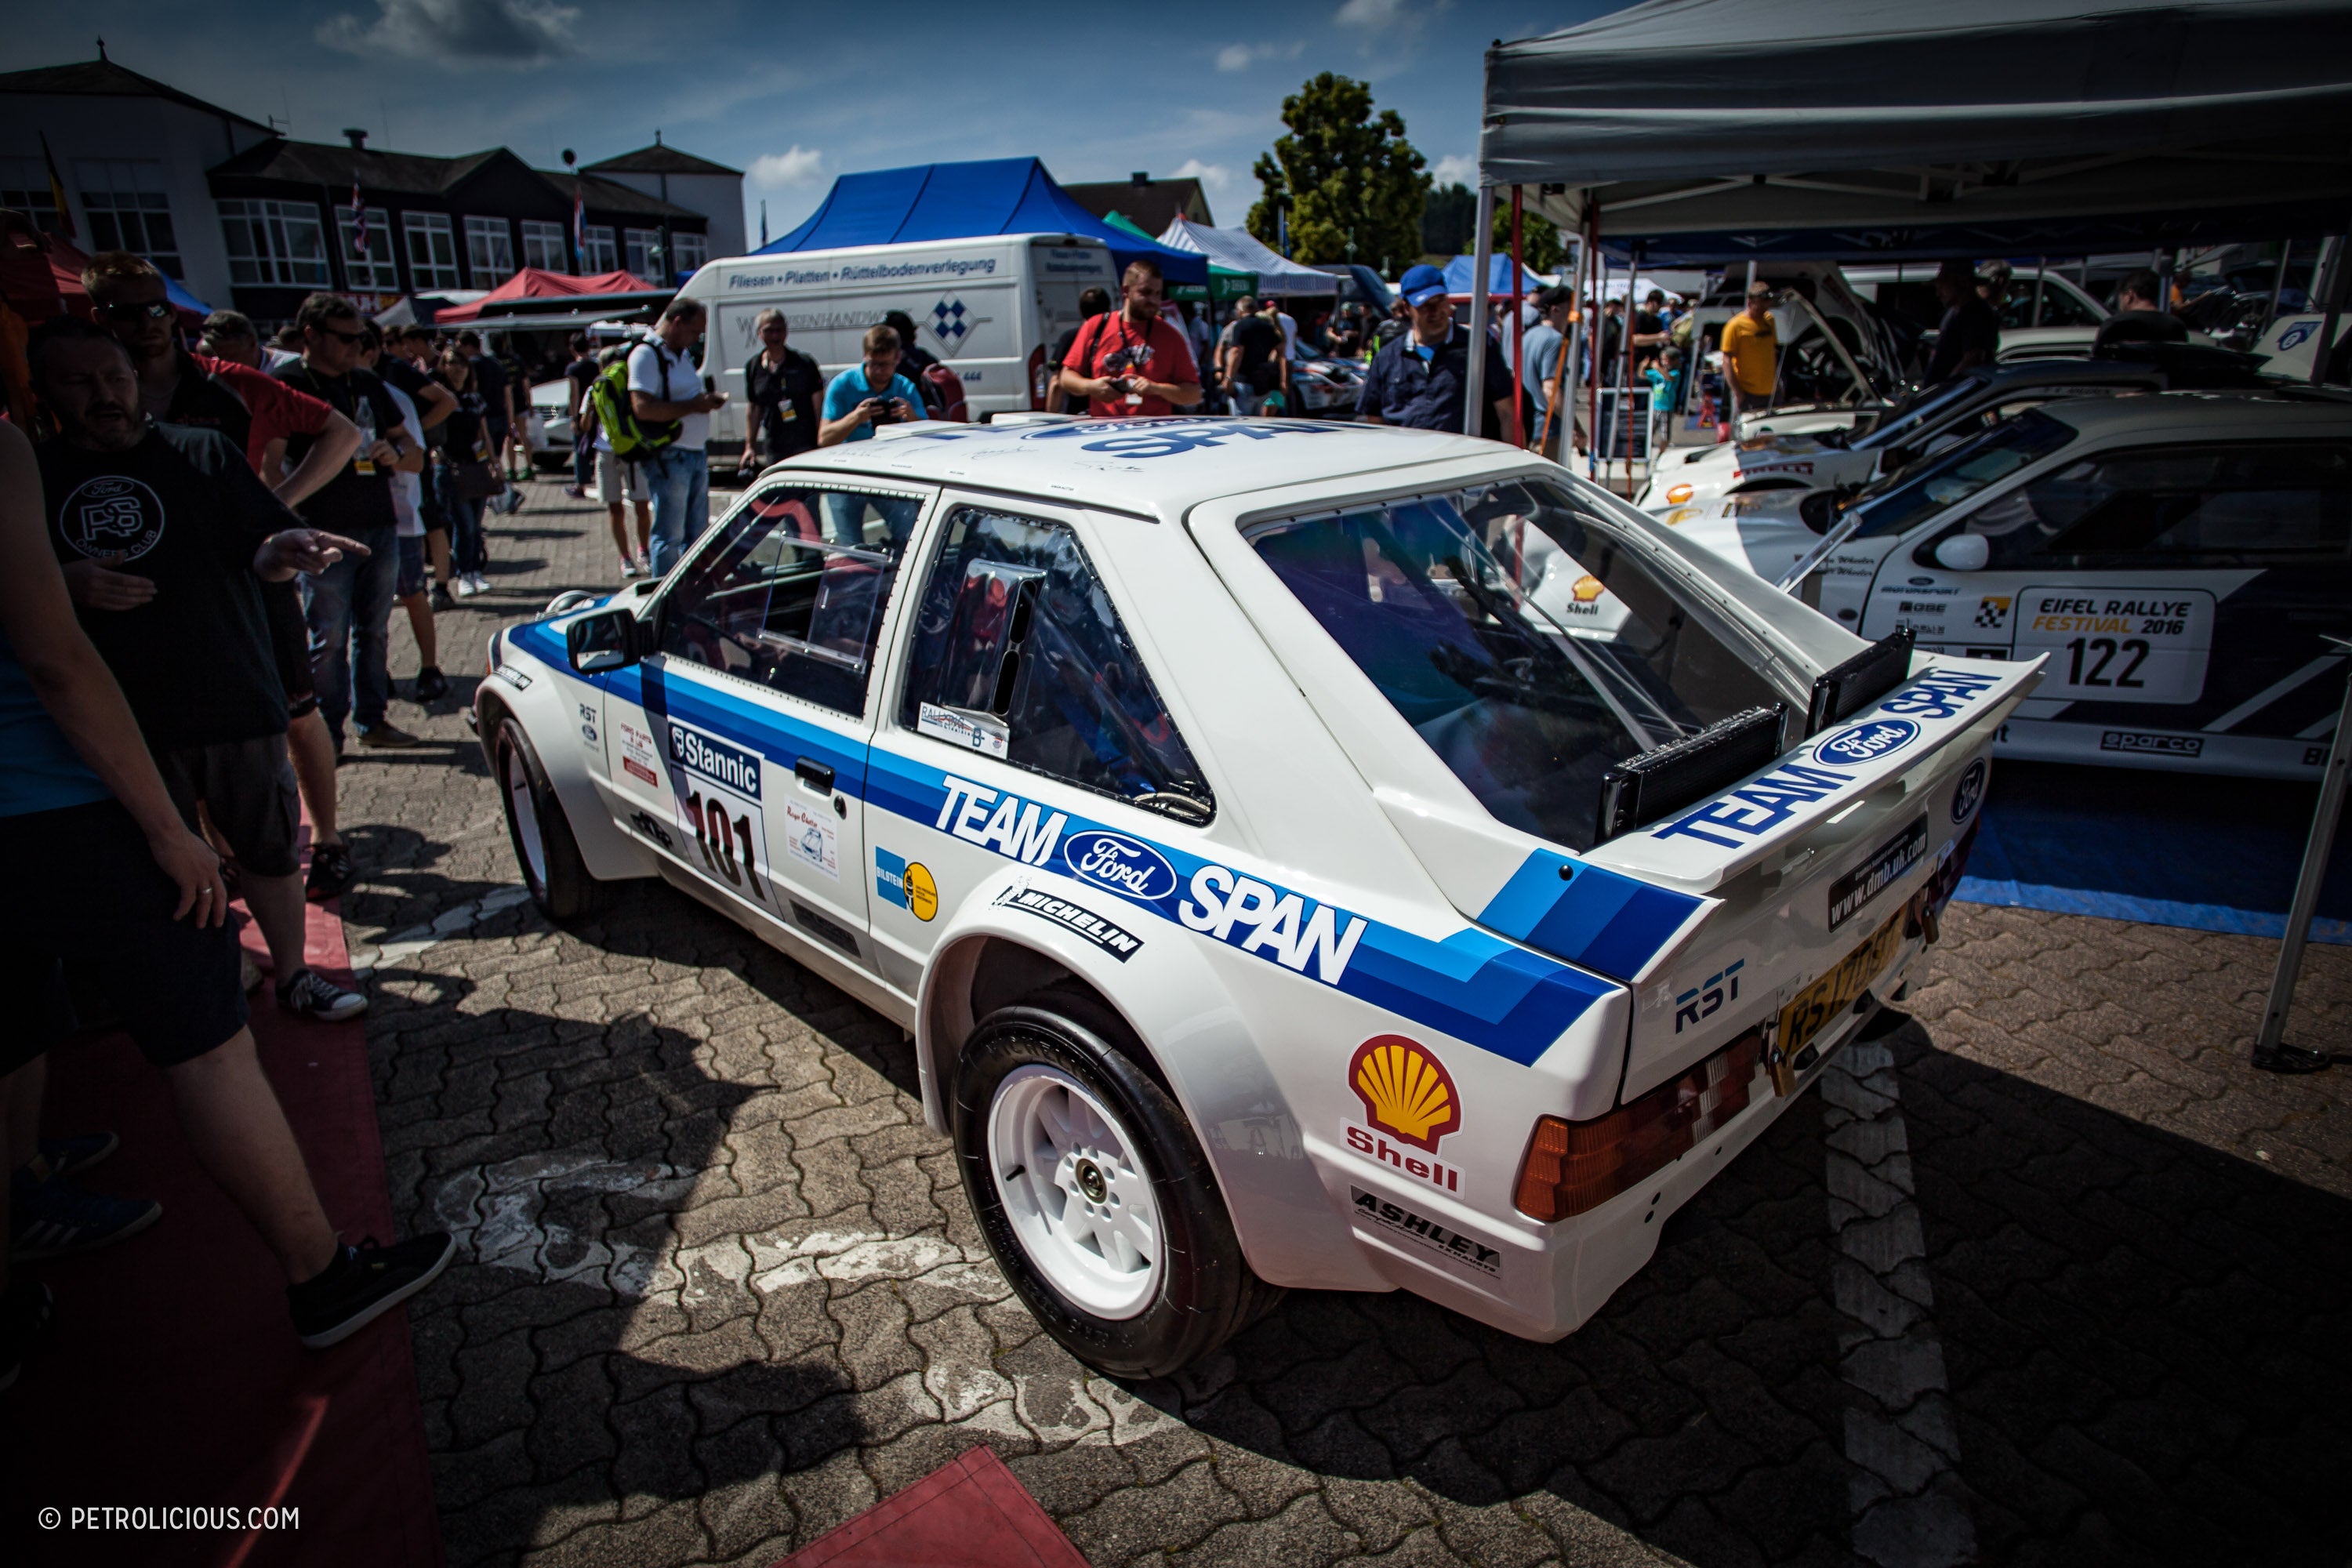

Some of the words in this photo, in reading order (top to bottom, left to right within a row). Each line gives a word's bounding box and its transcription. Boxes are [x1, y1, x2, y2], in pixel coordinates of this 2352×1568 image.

[728, 274, 775, 289] Fliesen
[783, 270, 829, 285] Platten
[1566, 602, 1599, 615] Shell
[2032, 615, 2133, 634] FESTIVAL
[2141, 619, 2185, 635] 2016
[2040, 598, 2097, 615] EIFEL
[2104, 600, 2192, 618] RALLYE
[2066, 637, 2150, 688] 122
[684, 731, 757, 793] Stannic
[1650, 761, 1856, 849] TEAM
[1828, 723, 1907, 760] Ford
[1880, 668, 2004, 721] SPAN
[2104, 732, 2201, 753] sparco
[686, 789, 768, 902] 101
[876, 866, 904, 890] BILSTEIN
[935, 775, 1069, 867] TEAM
[1079, 839, 1151, 896] Ford
[1178, 864, 1369, 985] SPAN
[1831, 832, 1927, 925] www.dmb.uk.com
[1020, 888, 1141, 953] MICHELIN
[1675, 957, 1745, 1036] RST
[1346, 1125, 1458, 1192] Shell
[1354, 1192, 1501, 1262] ASHLEY
[1357, 1207, 1428, 1241] Competition
[1438, 1243, 1497, 1273] EXHAUSTS
